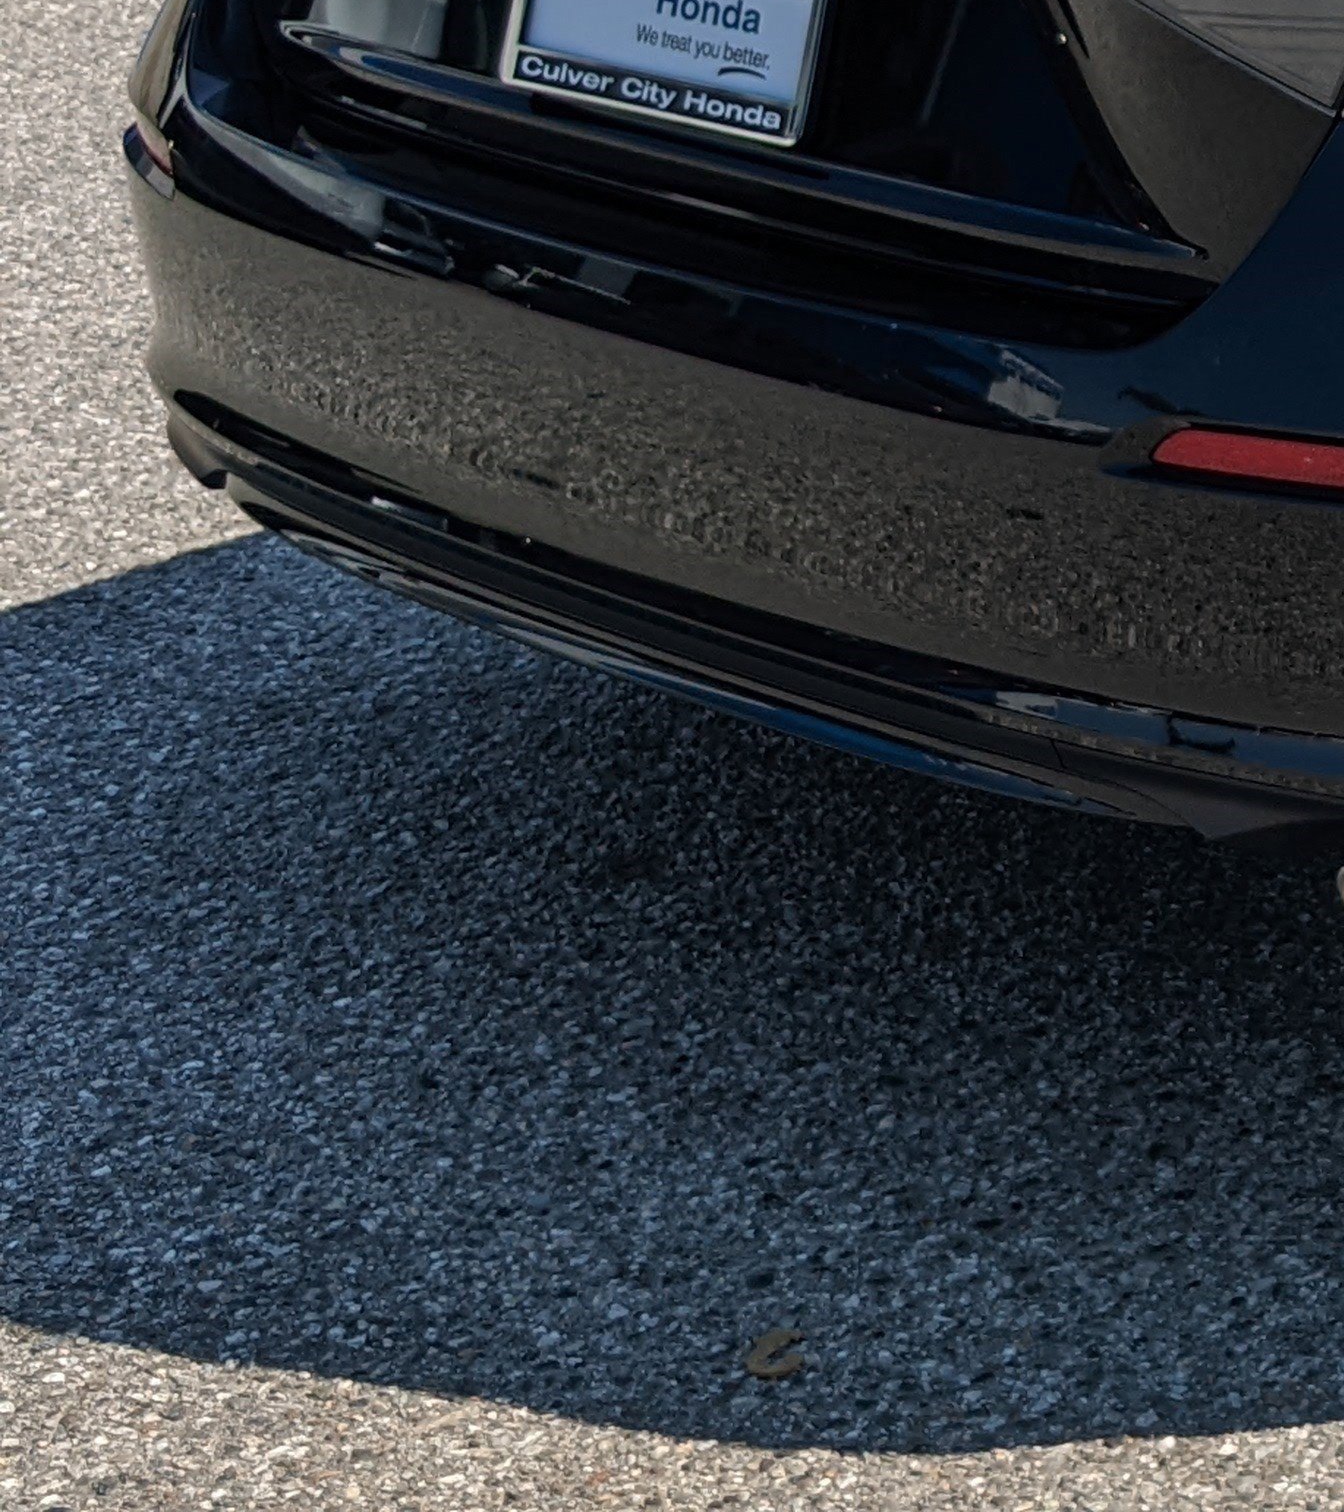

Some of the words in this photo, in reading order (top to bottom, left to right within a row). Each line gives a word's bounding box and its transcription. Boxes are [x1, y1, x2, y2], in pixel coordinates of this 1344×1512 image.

[636, 23, 660, 46] We
[660, 30, 692, 54] treat
[693, 38, 720, 59] you
[520, 55, 615, 91] Culver
[620, 76, 677, 111] City
[683, 89, 783, 130] Honda
